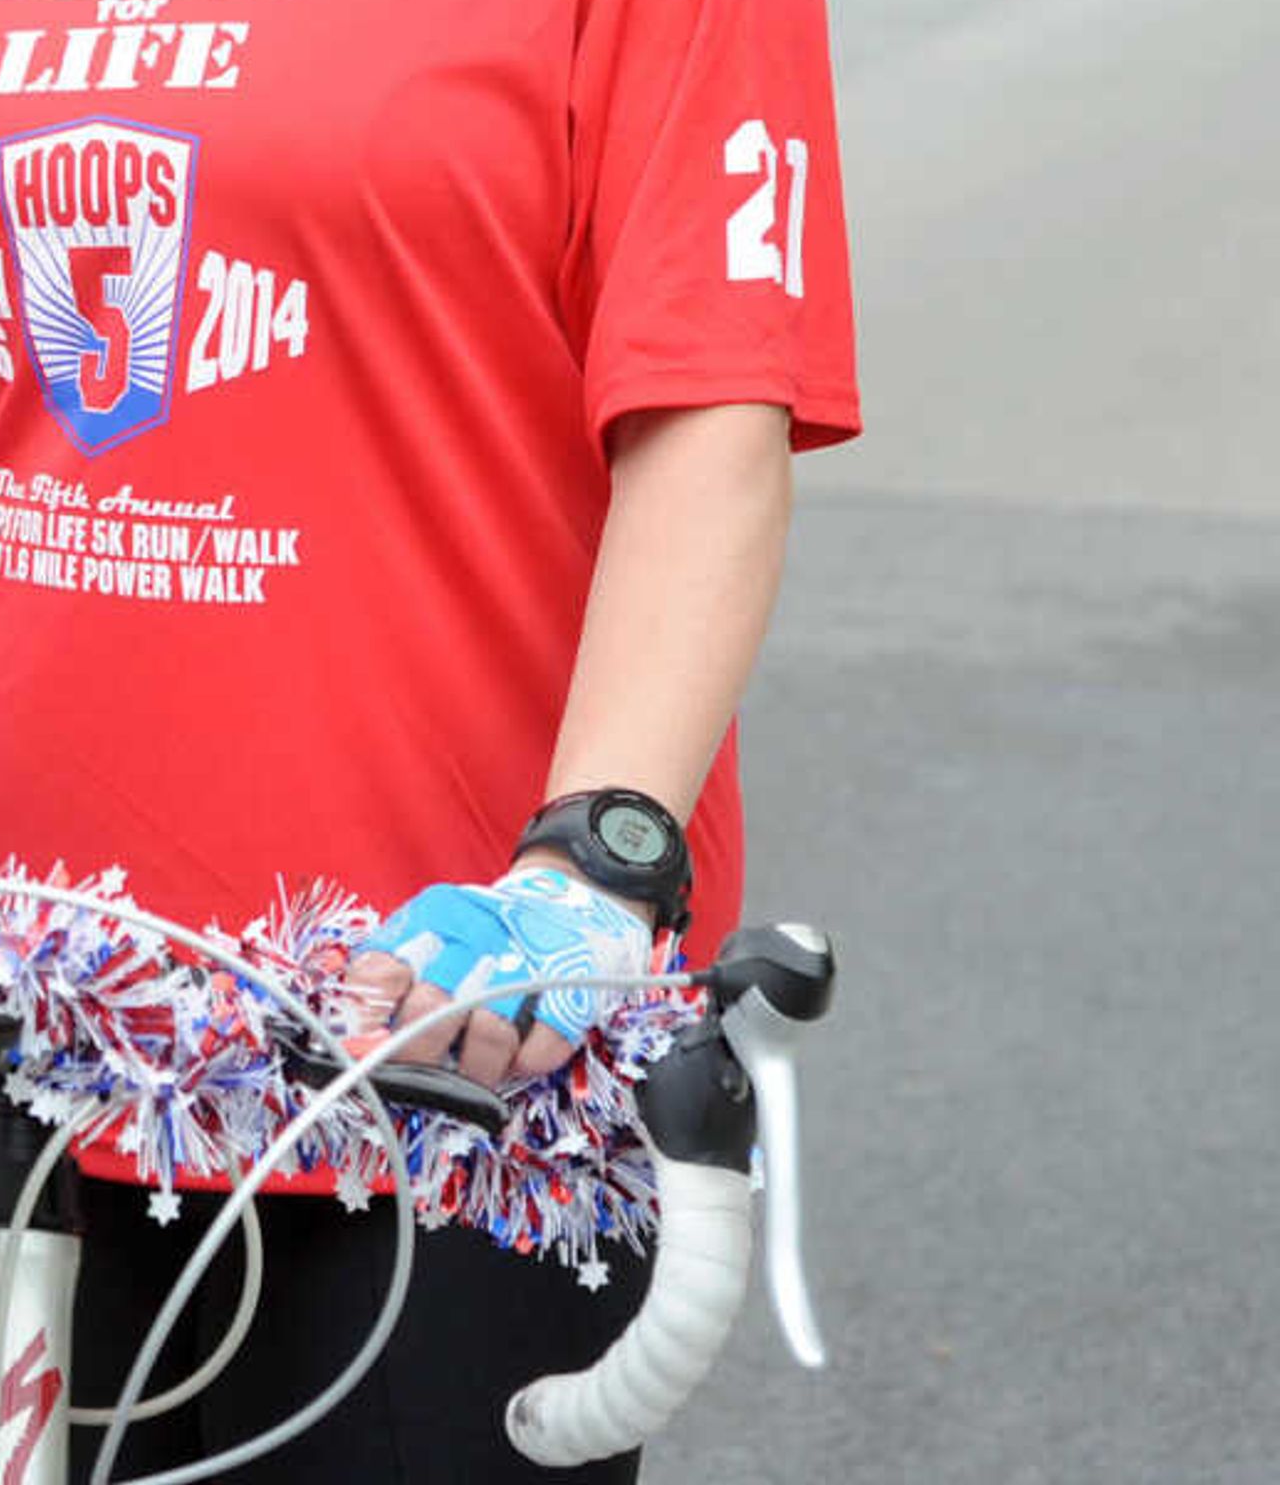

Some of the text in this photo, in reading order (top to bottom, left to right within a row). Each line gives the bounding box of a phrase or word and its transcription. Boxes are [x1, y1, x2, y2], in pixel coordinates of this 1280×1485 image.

[13, 139, 177, 230] HOOPS
[67, 245, 132, 413] 5
[185, 250, 309, 394] 2014
[29, 473, 91, 511] Fifth
[97, 484, 236, 521] Annual
[45, 512, 89, 552] LIFE
[91, 517, 126, 558] 5K
[32, 550, 79, 591] MILE
[82, 557, 173, 602] POWER
[179, 565, 267, 605] WALK
